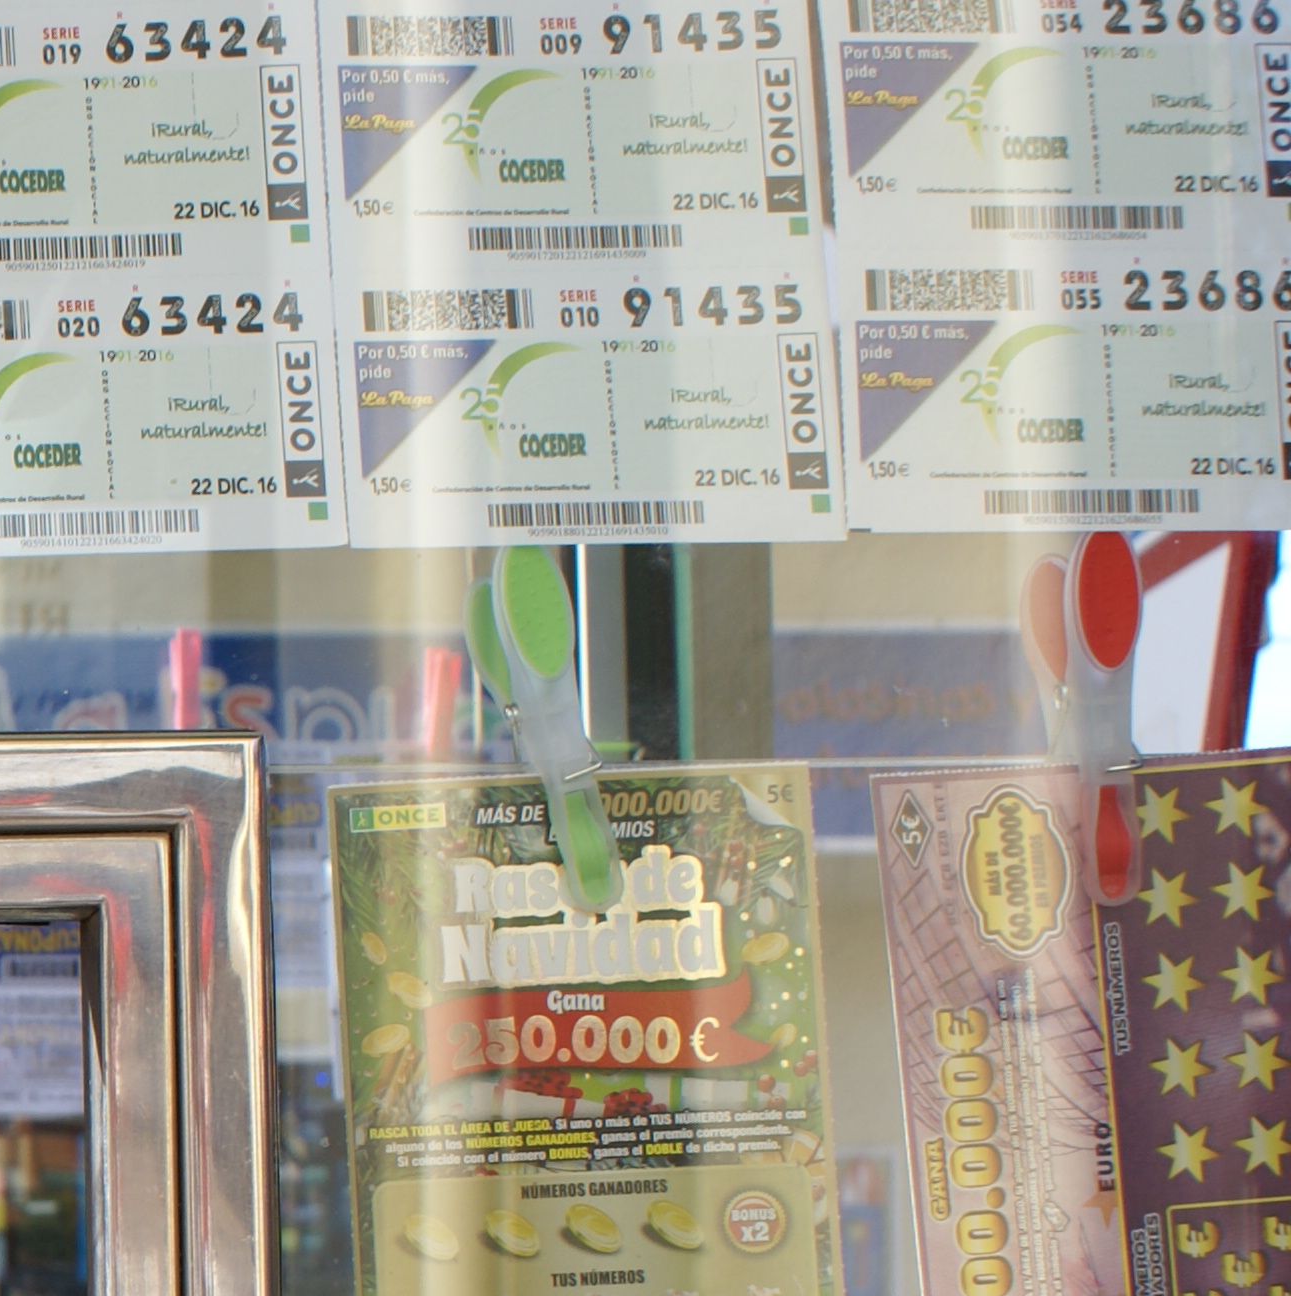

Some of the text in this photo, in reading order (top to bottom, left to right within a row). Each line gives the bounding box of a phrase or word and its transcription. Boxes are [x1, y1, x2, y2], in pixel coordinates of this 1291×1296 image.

[43, 17, 286, 65] 019 63424
[540, 10, 782, 55] 009 91435
[1042, 0, 1278, 35] 054 23686
[269, 75, 298, 174] ONCE
[766, 67, 795, 166] ONCE
[1265, 52, 1291, 150] ONCE
[560, 285, 803, 328] 010 91435
[1062, 269, 1291, 312] 055 23686
[58, 292, 303, 338] 020 63424
[286, 351, 316, 450] ONCE
[786, 342, 818, 443] ONCE
[14, 443, 82, 468] COCEDER
[378, 807, 442, 826] ONCE
[442, 902, 725, 985] Navidad
[547, 991, 604, 1014] Gana
[446, 1016, 719, 1068] 250.000 €
[924, 1137, 952, 1221] GANA
[1094, 1120, 1117, 1194] EURO
[521, 1179, 668, 1200] NÚMEROS GANADORES
